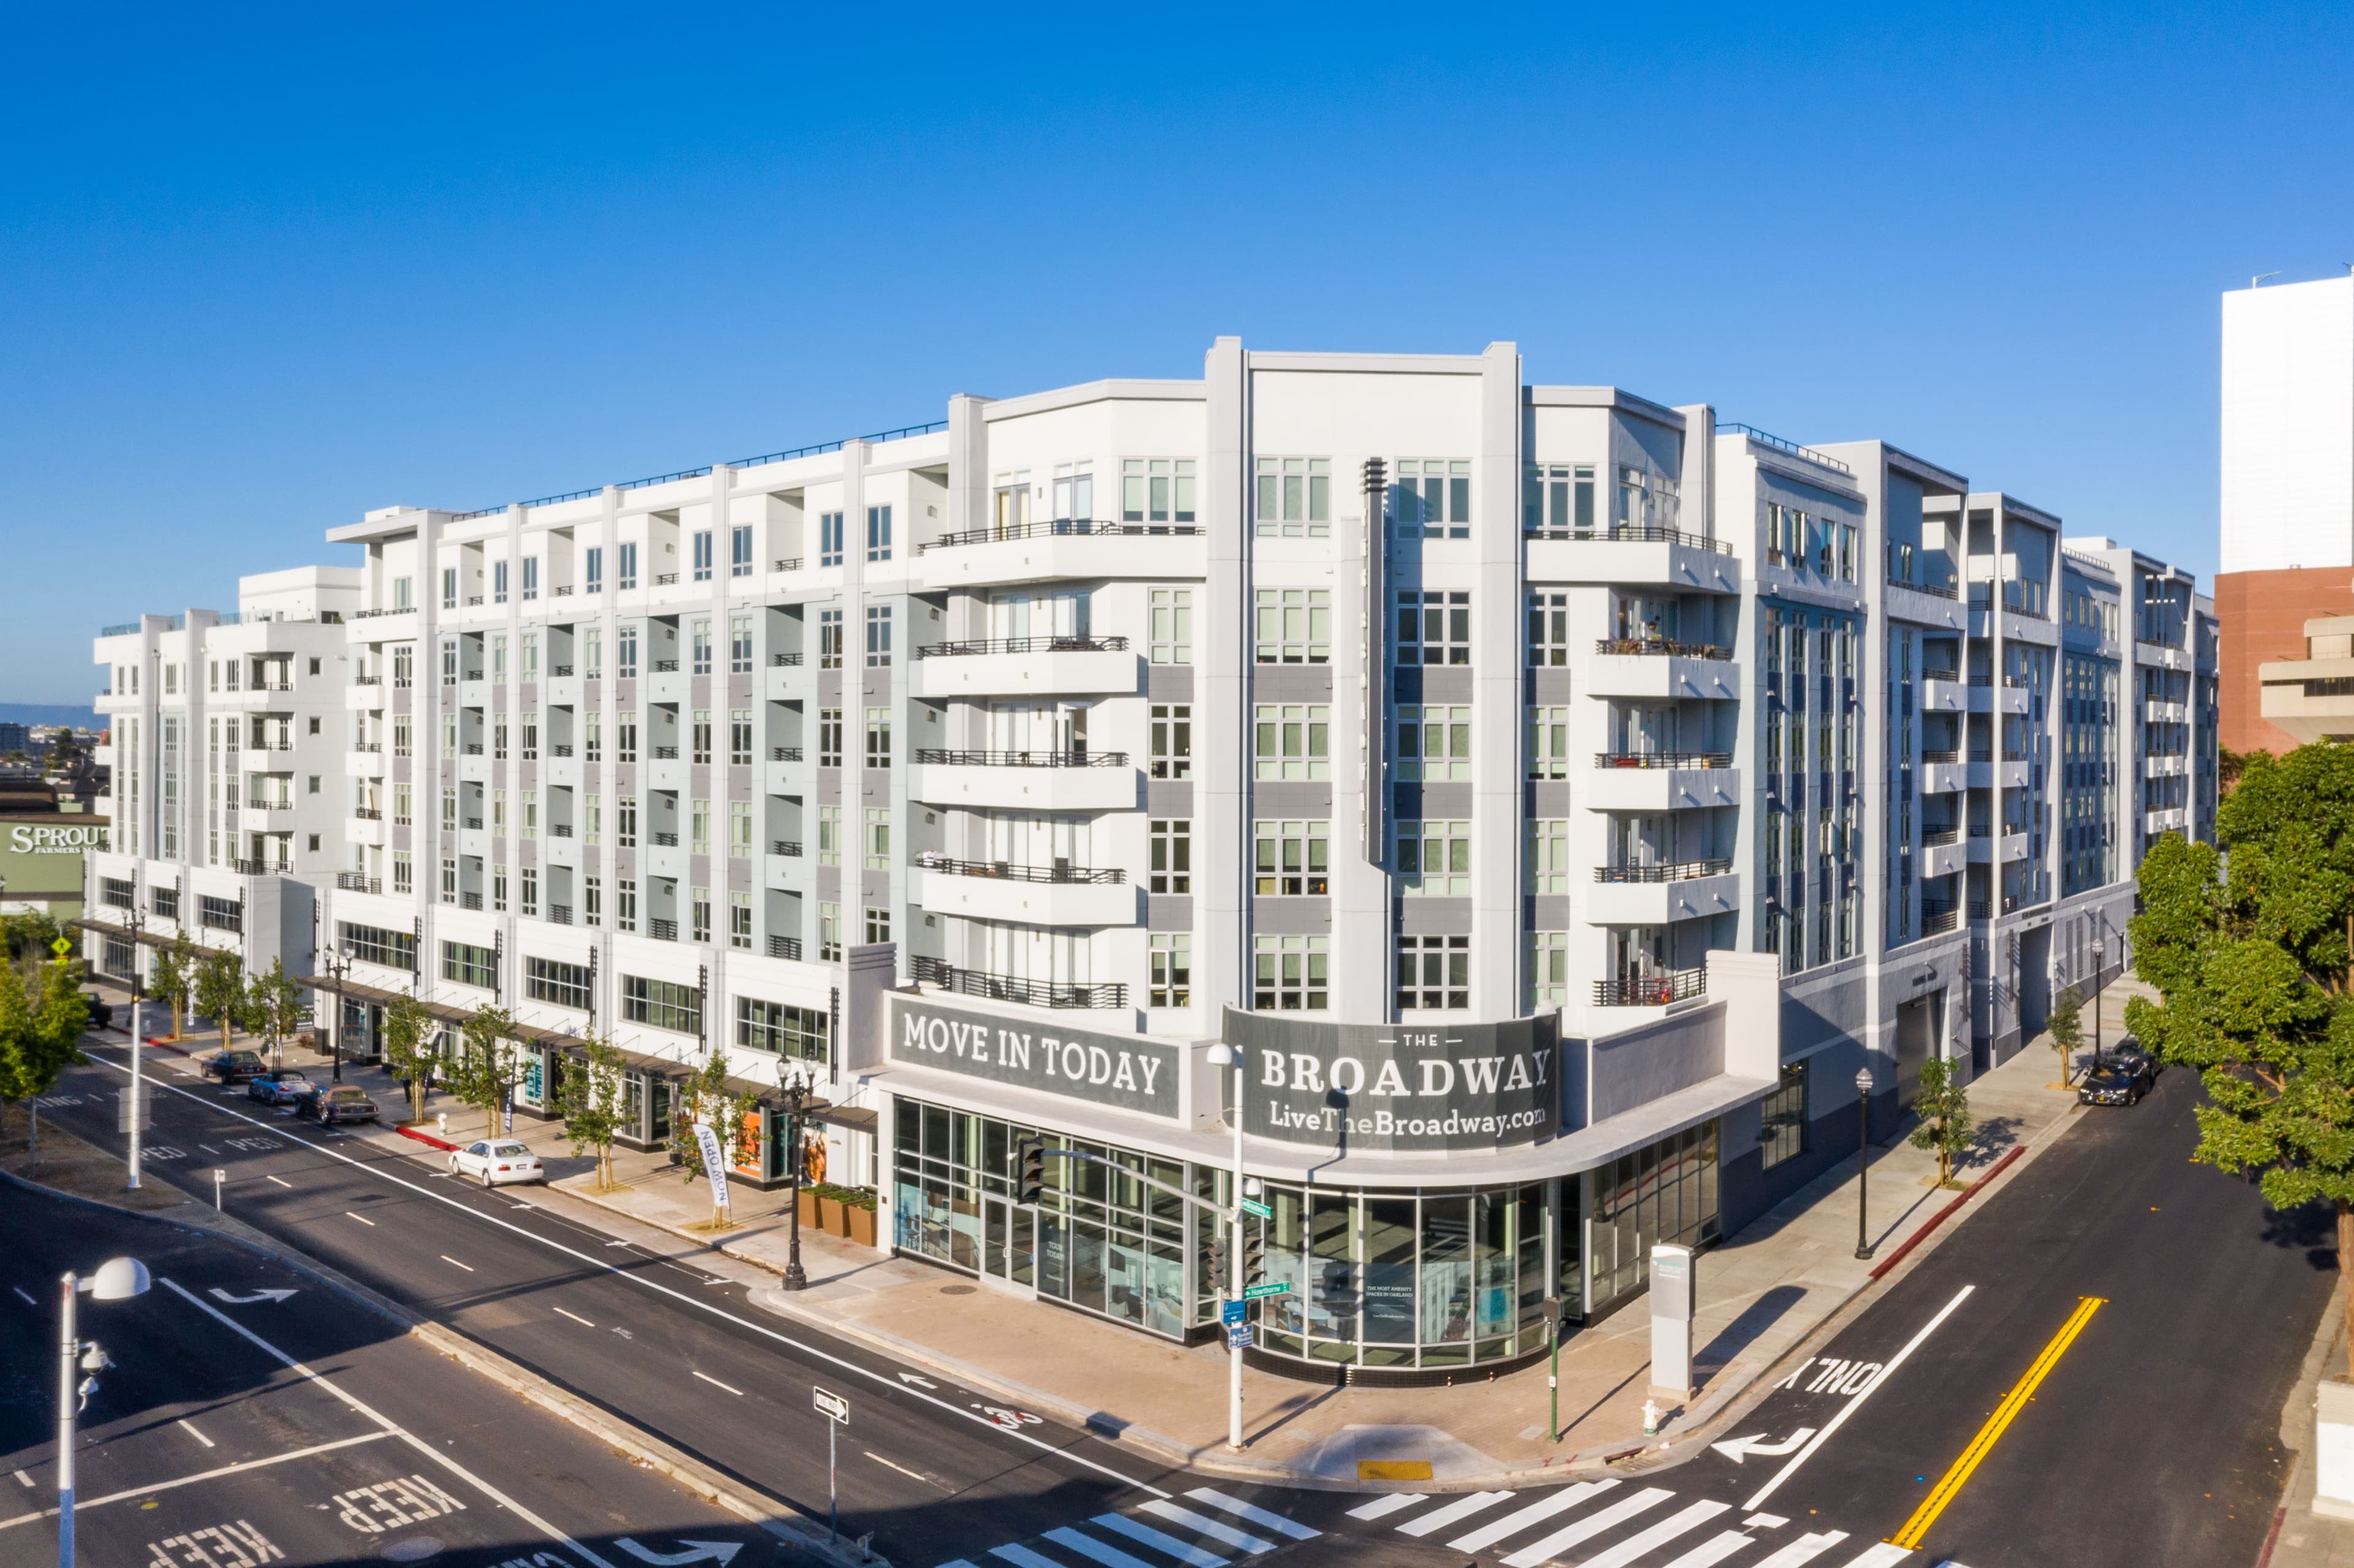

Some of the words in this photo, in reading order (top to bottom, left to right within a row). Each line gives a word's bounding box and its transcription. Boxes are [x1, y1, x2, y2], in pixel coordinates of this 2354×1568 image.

[904, 1013, 988, 1062] MOVE
[998, 1030, 1031, 1070] IN
[1042, 1038, 1161, 1095] TODAY
[1403, 1034, 1438, 1046] THE
[1260, 1049, 1551, 1096] BROADWAY
[1270, 1101, 1546, 1138] LiveTheBroadway.com
[224, 1137, 283, 1151] PED
[701, 1131, 720, 1165] OPEN
[713, 1170, 726, 1201] NOW
[1251, 1286, 1281, 1296] Hawthorne
[1772, 1357, 1883, 1395] ONLY
[332, 1474, 468, 1533] KEEP
